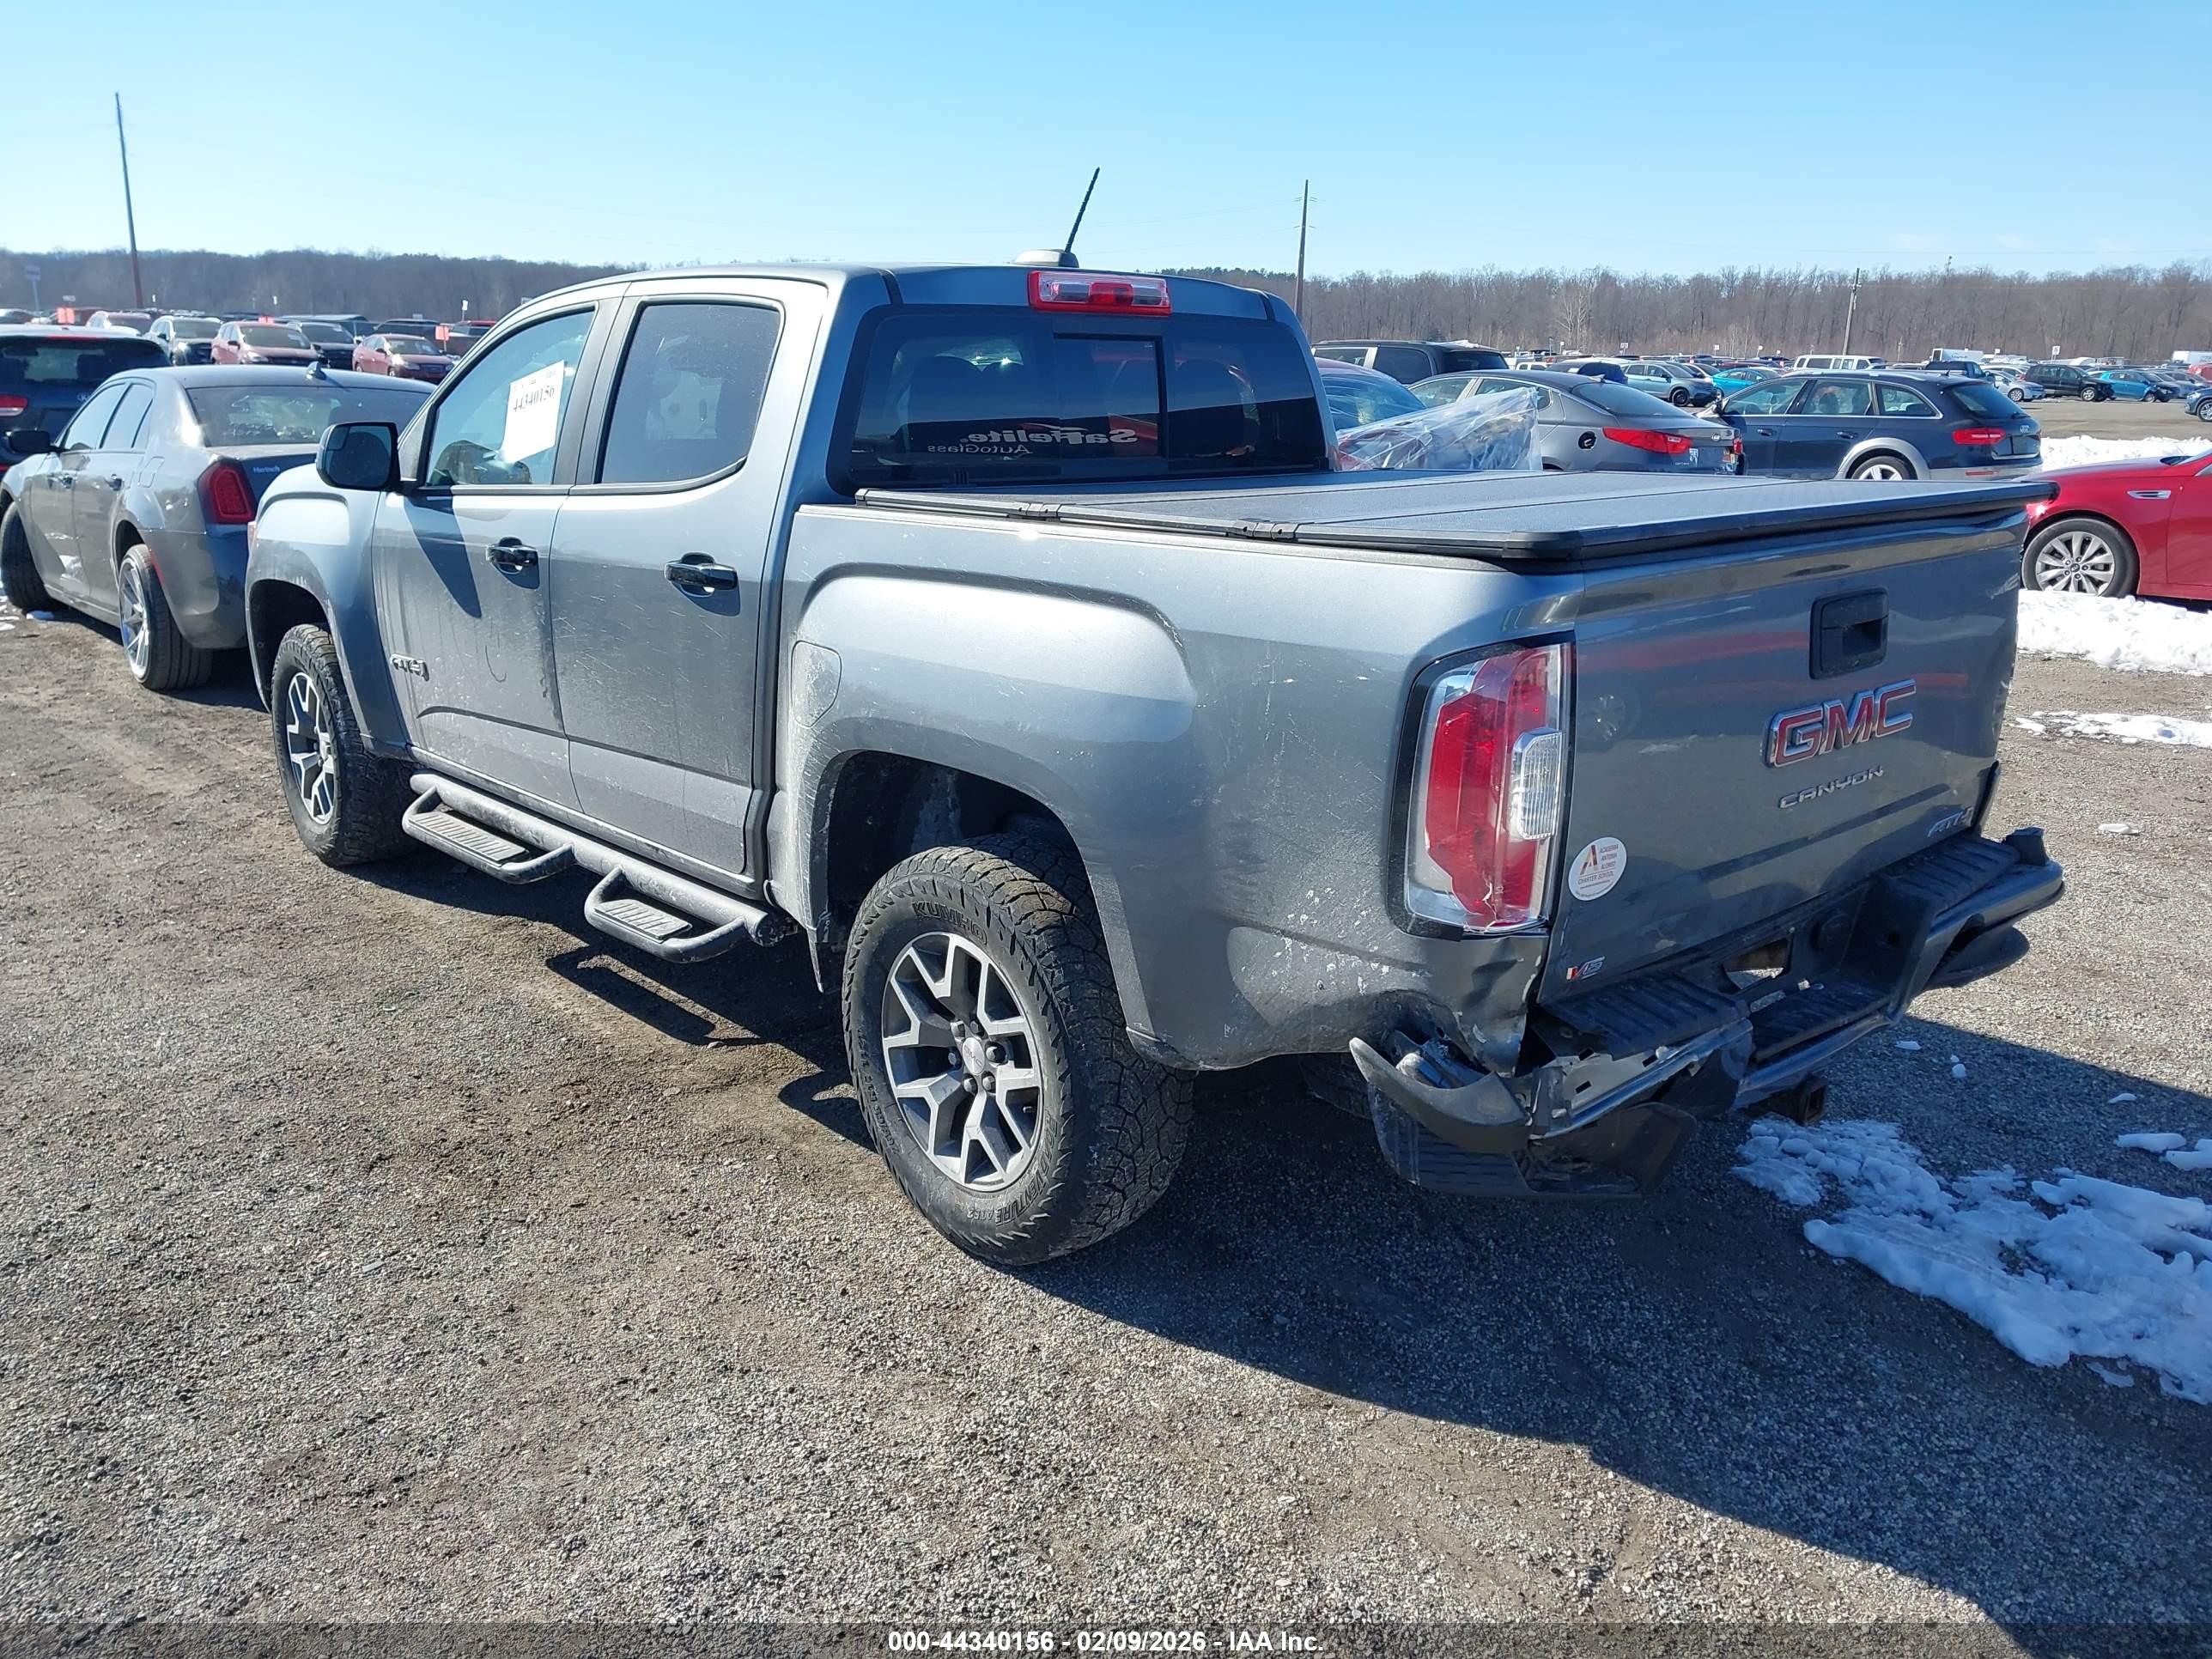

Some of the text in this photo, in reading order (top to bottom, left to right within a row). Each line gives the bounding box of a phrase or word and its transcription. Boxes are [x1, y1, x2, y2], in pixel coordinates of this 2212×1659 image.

[1767, 678, 1917, 768] GMC
[1778, 764, 1885, 809] CANYON
[911, 901, 988, 946] KUMHO
[995, 1168, 1047, 1226] VENTURE
